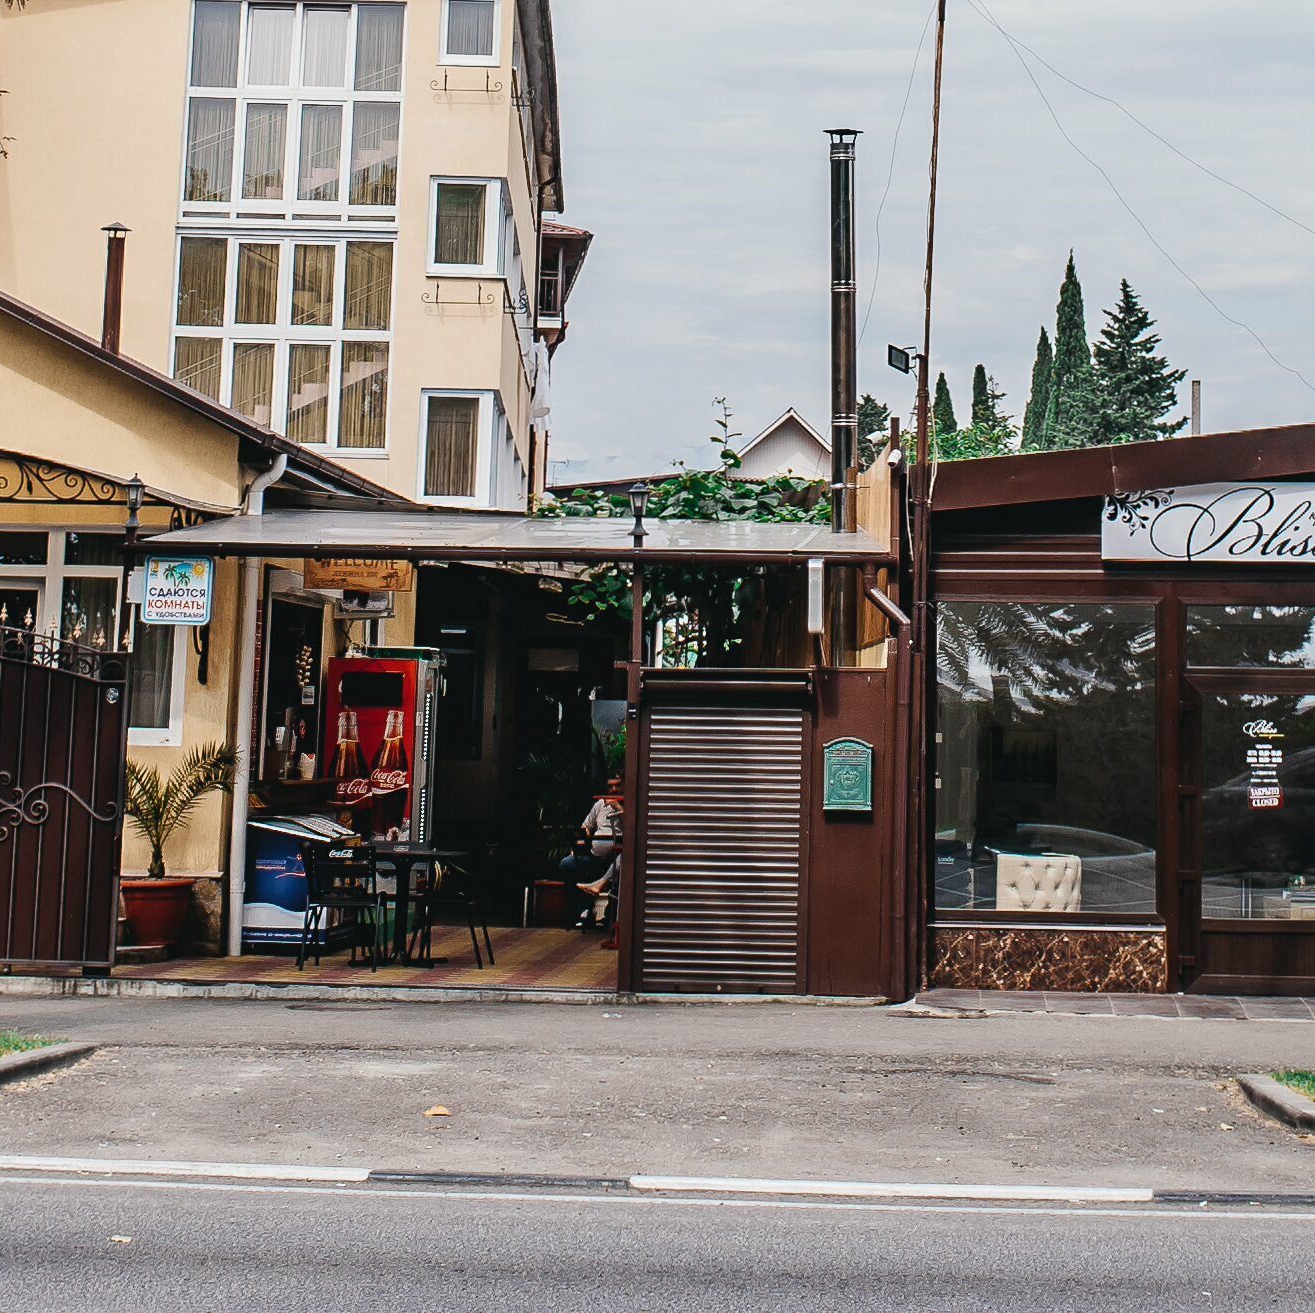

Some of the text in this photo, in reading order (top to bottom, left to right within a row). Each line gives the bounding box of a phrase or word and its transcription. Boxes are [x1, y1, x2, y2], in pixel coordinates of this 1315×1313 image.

[149, 587, 206, 598] СДАЮТСЯ
[148, 599, 204, 610] КОМНАТЫ
[156, 611, 204, 619] УДОБСТВАМИ
